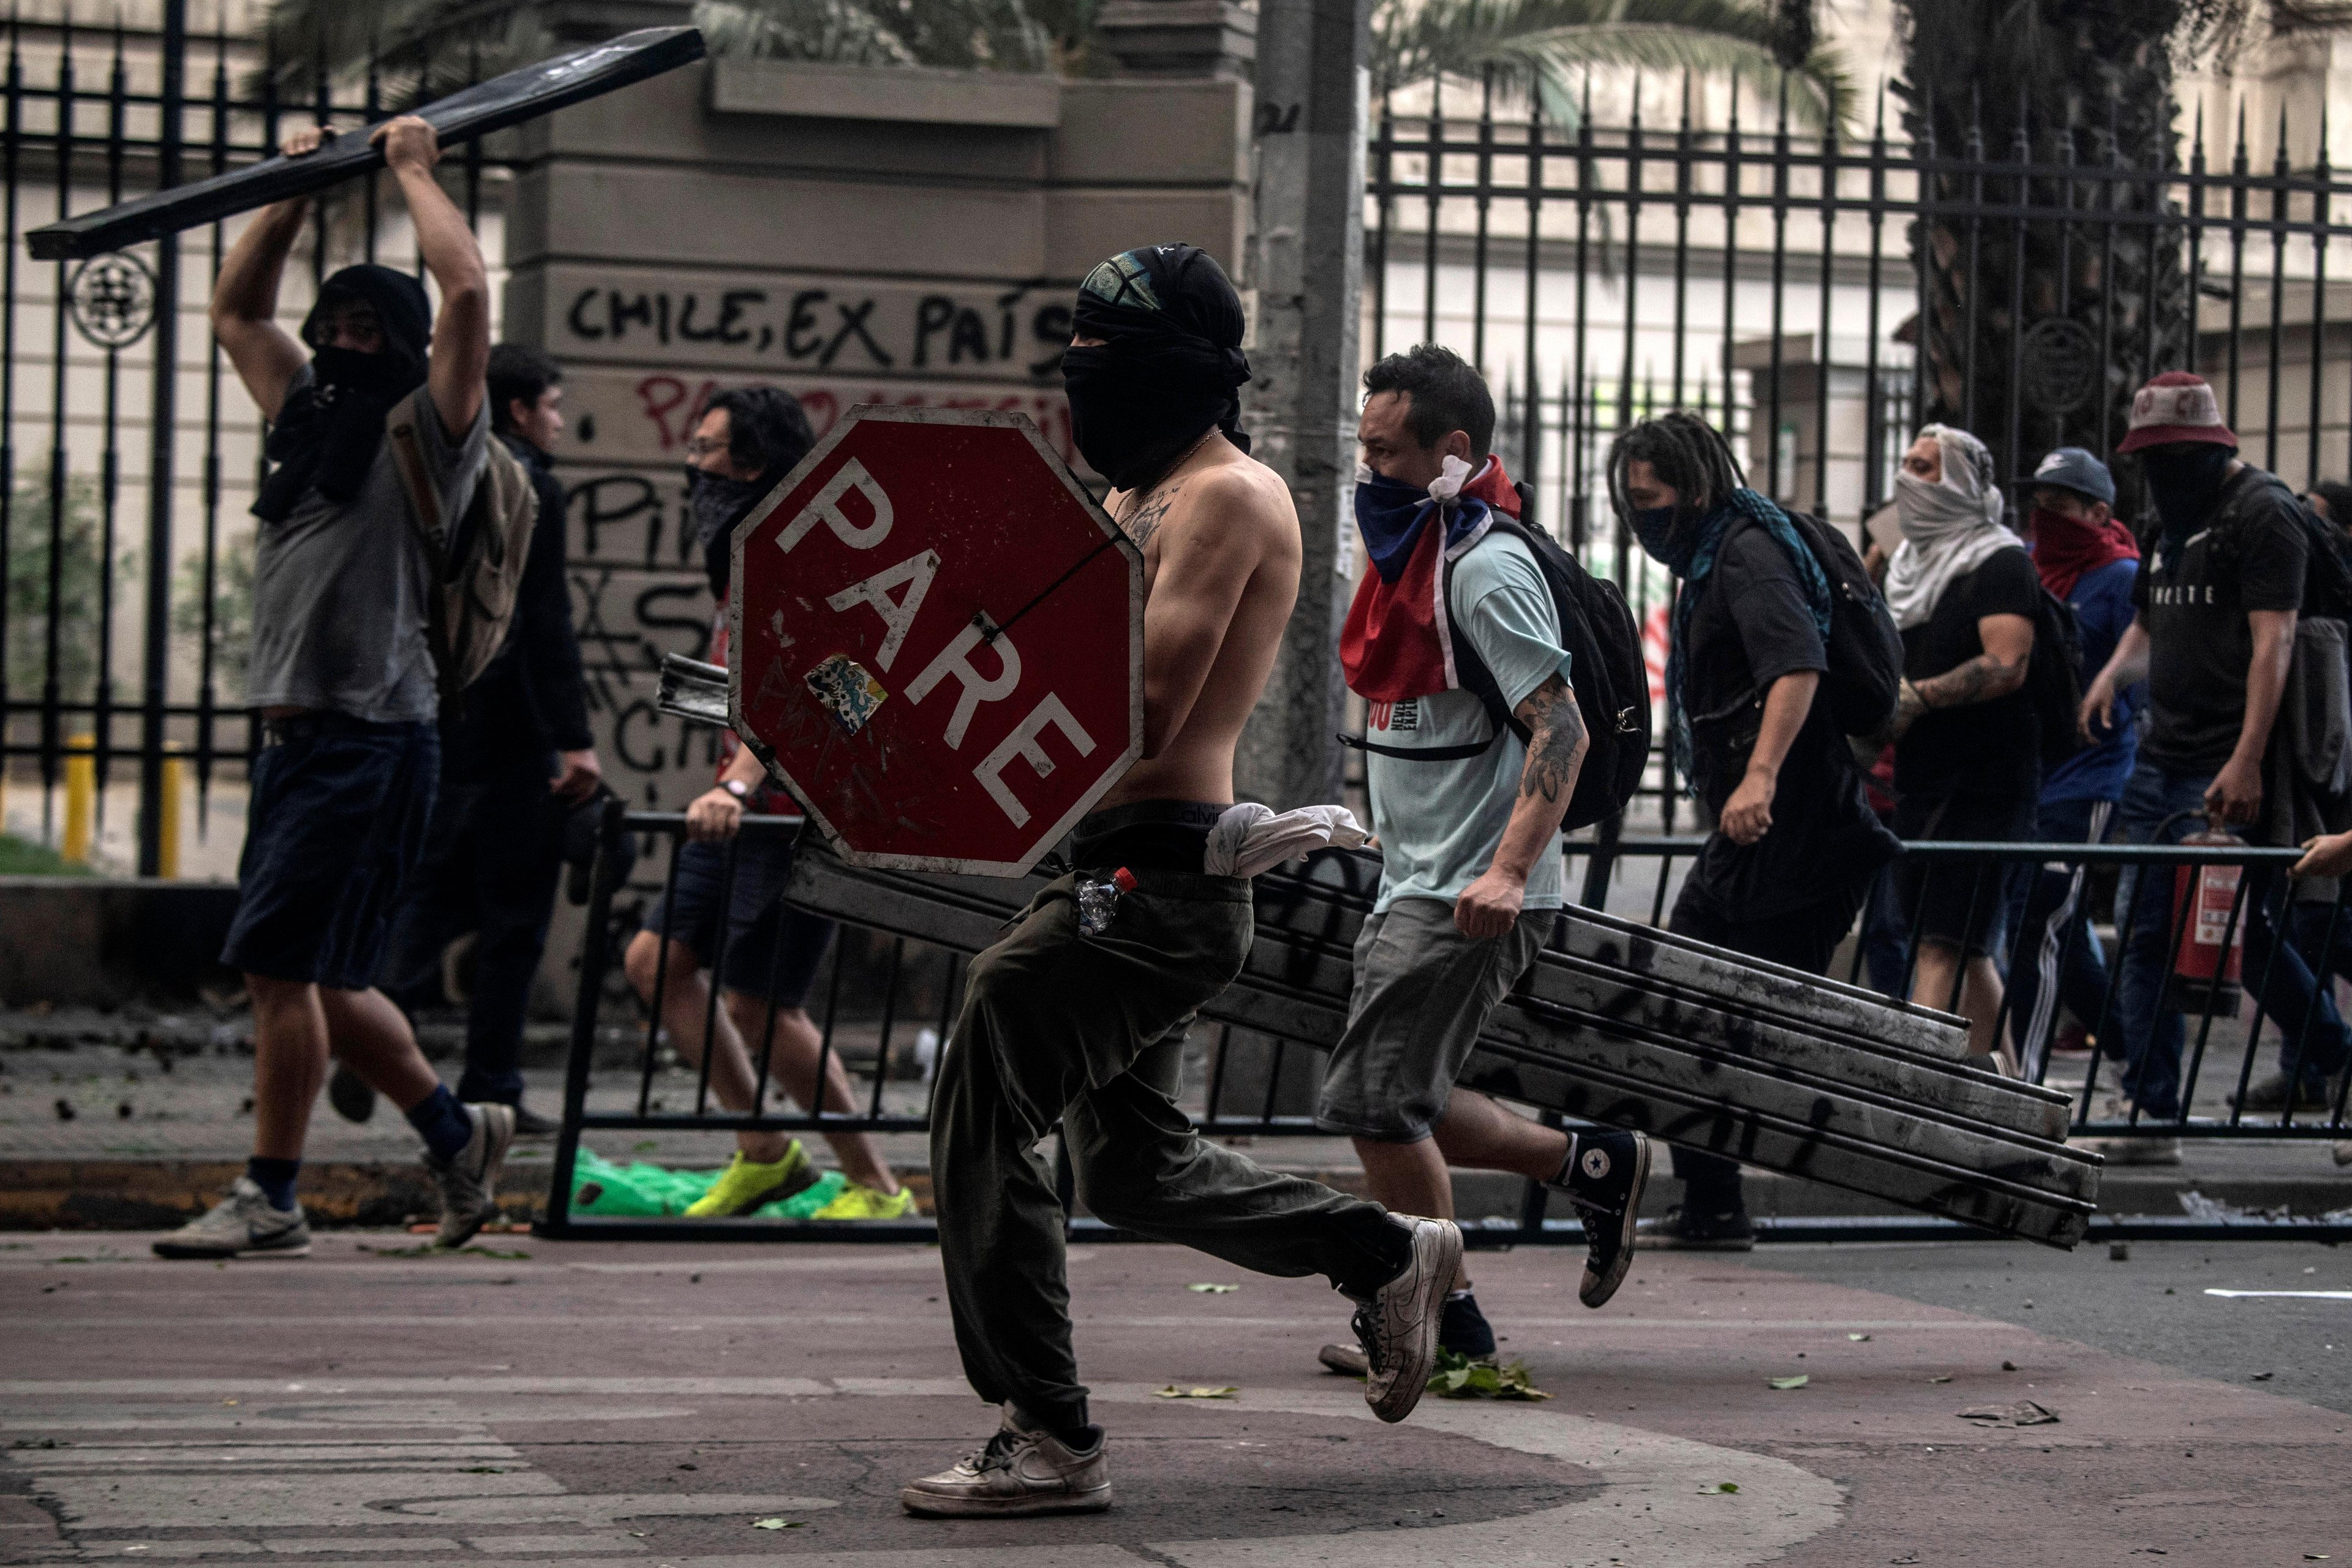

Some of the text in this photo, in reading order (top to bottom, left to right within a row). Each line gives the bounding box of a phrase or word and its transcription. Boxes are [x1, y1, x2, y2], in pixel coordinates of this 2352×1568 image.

[566, 288, 774, 352] CHILE,
[784, 289, 893, 368] EX
[774, 456, 1097, 829] PARE
